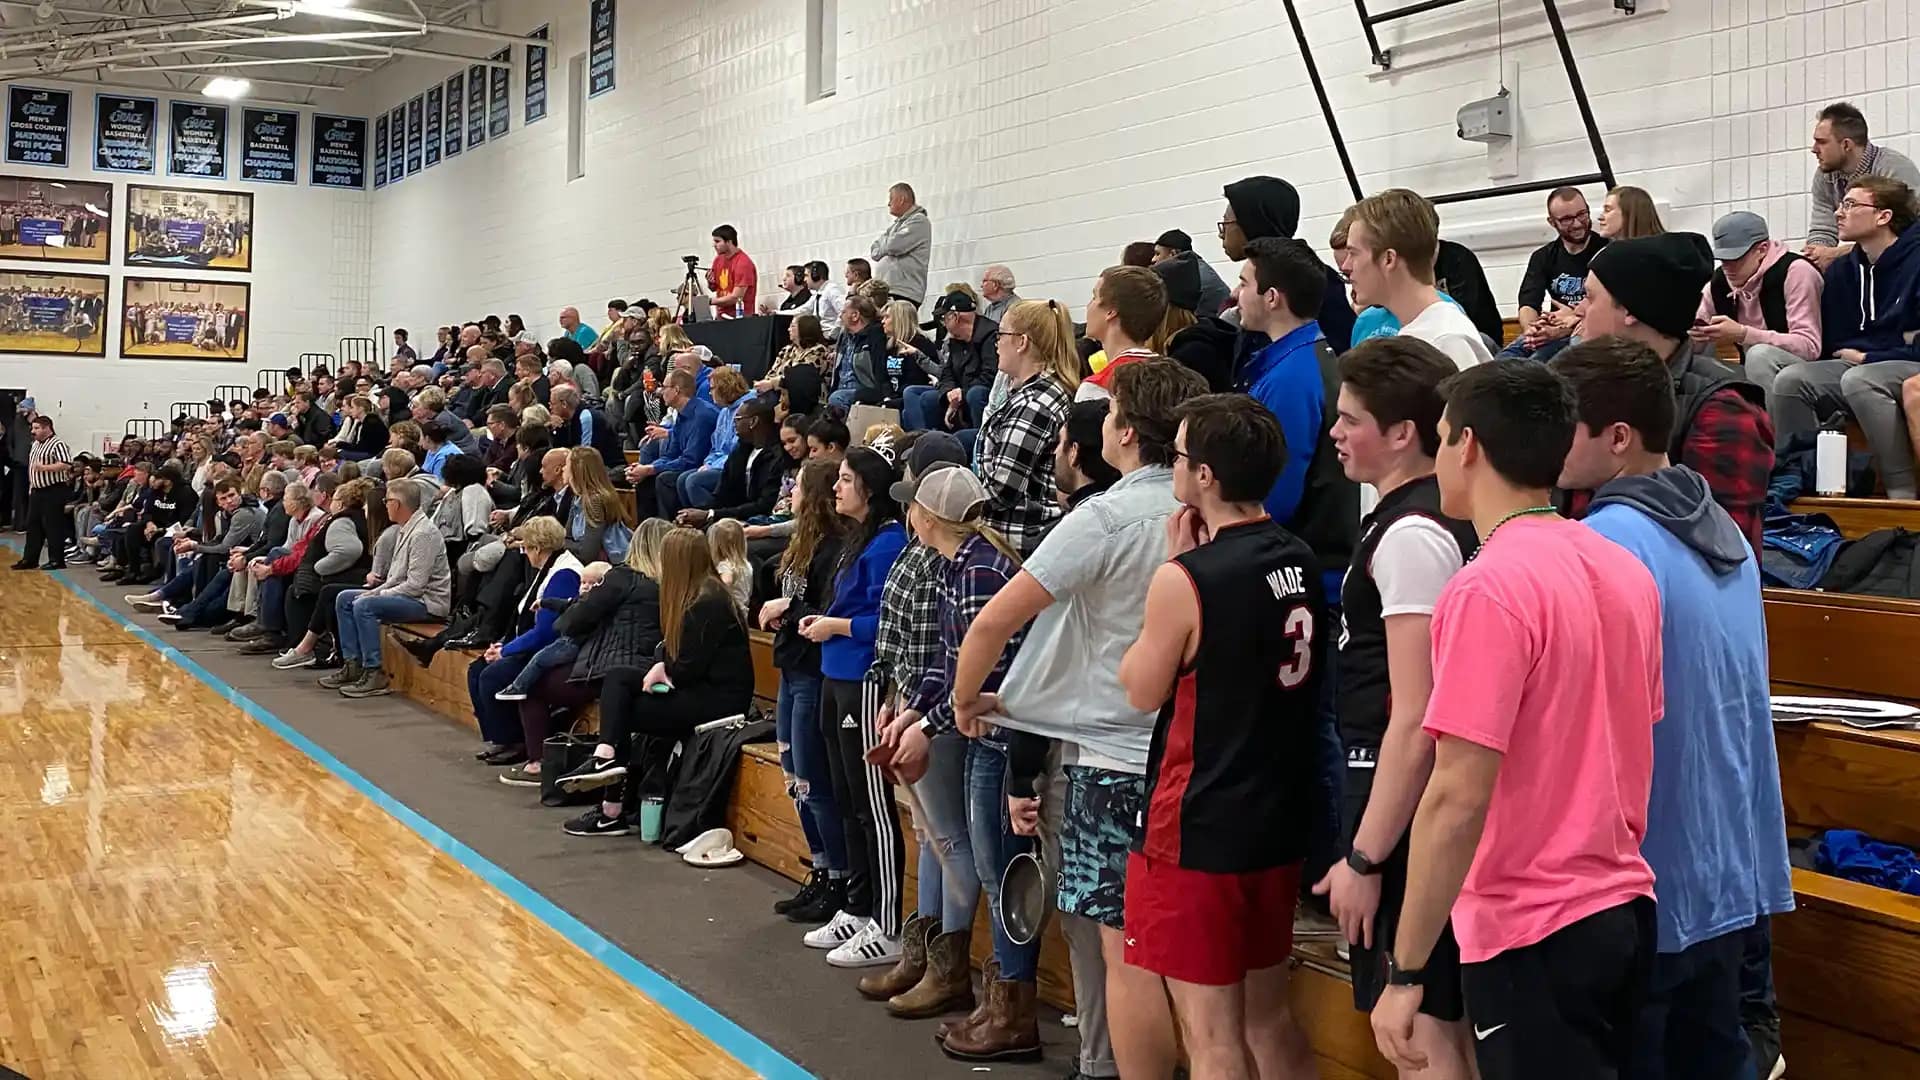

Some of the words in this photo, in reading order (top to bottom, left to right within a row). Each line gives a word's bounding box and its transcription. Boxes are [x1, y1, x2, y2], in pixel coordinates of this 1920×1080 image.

[10, 121, 33, 129] CROSS
[34, 123, 66, 132] COUNTRY
[15, 131, 62, 142] NATIONAL
[105, 130, 147, 140] BASKETBALL
[178, 136, 218, 145] BASKETBALL
[260, 135, 280, 143] MEN'S
[33, 141, 62, 152] PLACE
[250, 141, 289, 151] BASKETBALL
[320, 147, 359, 157] BASKETBALL
[244, 158, 294, 170] CHAMPIONS
[319, 155, 360, 167] NATIONAL
[1266, 566, 1306, 600] WADE
[1278, 605, 1313, 688] 3
